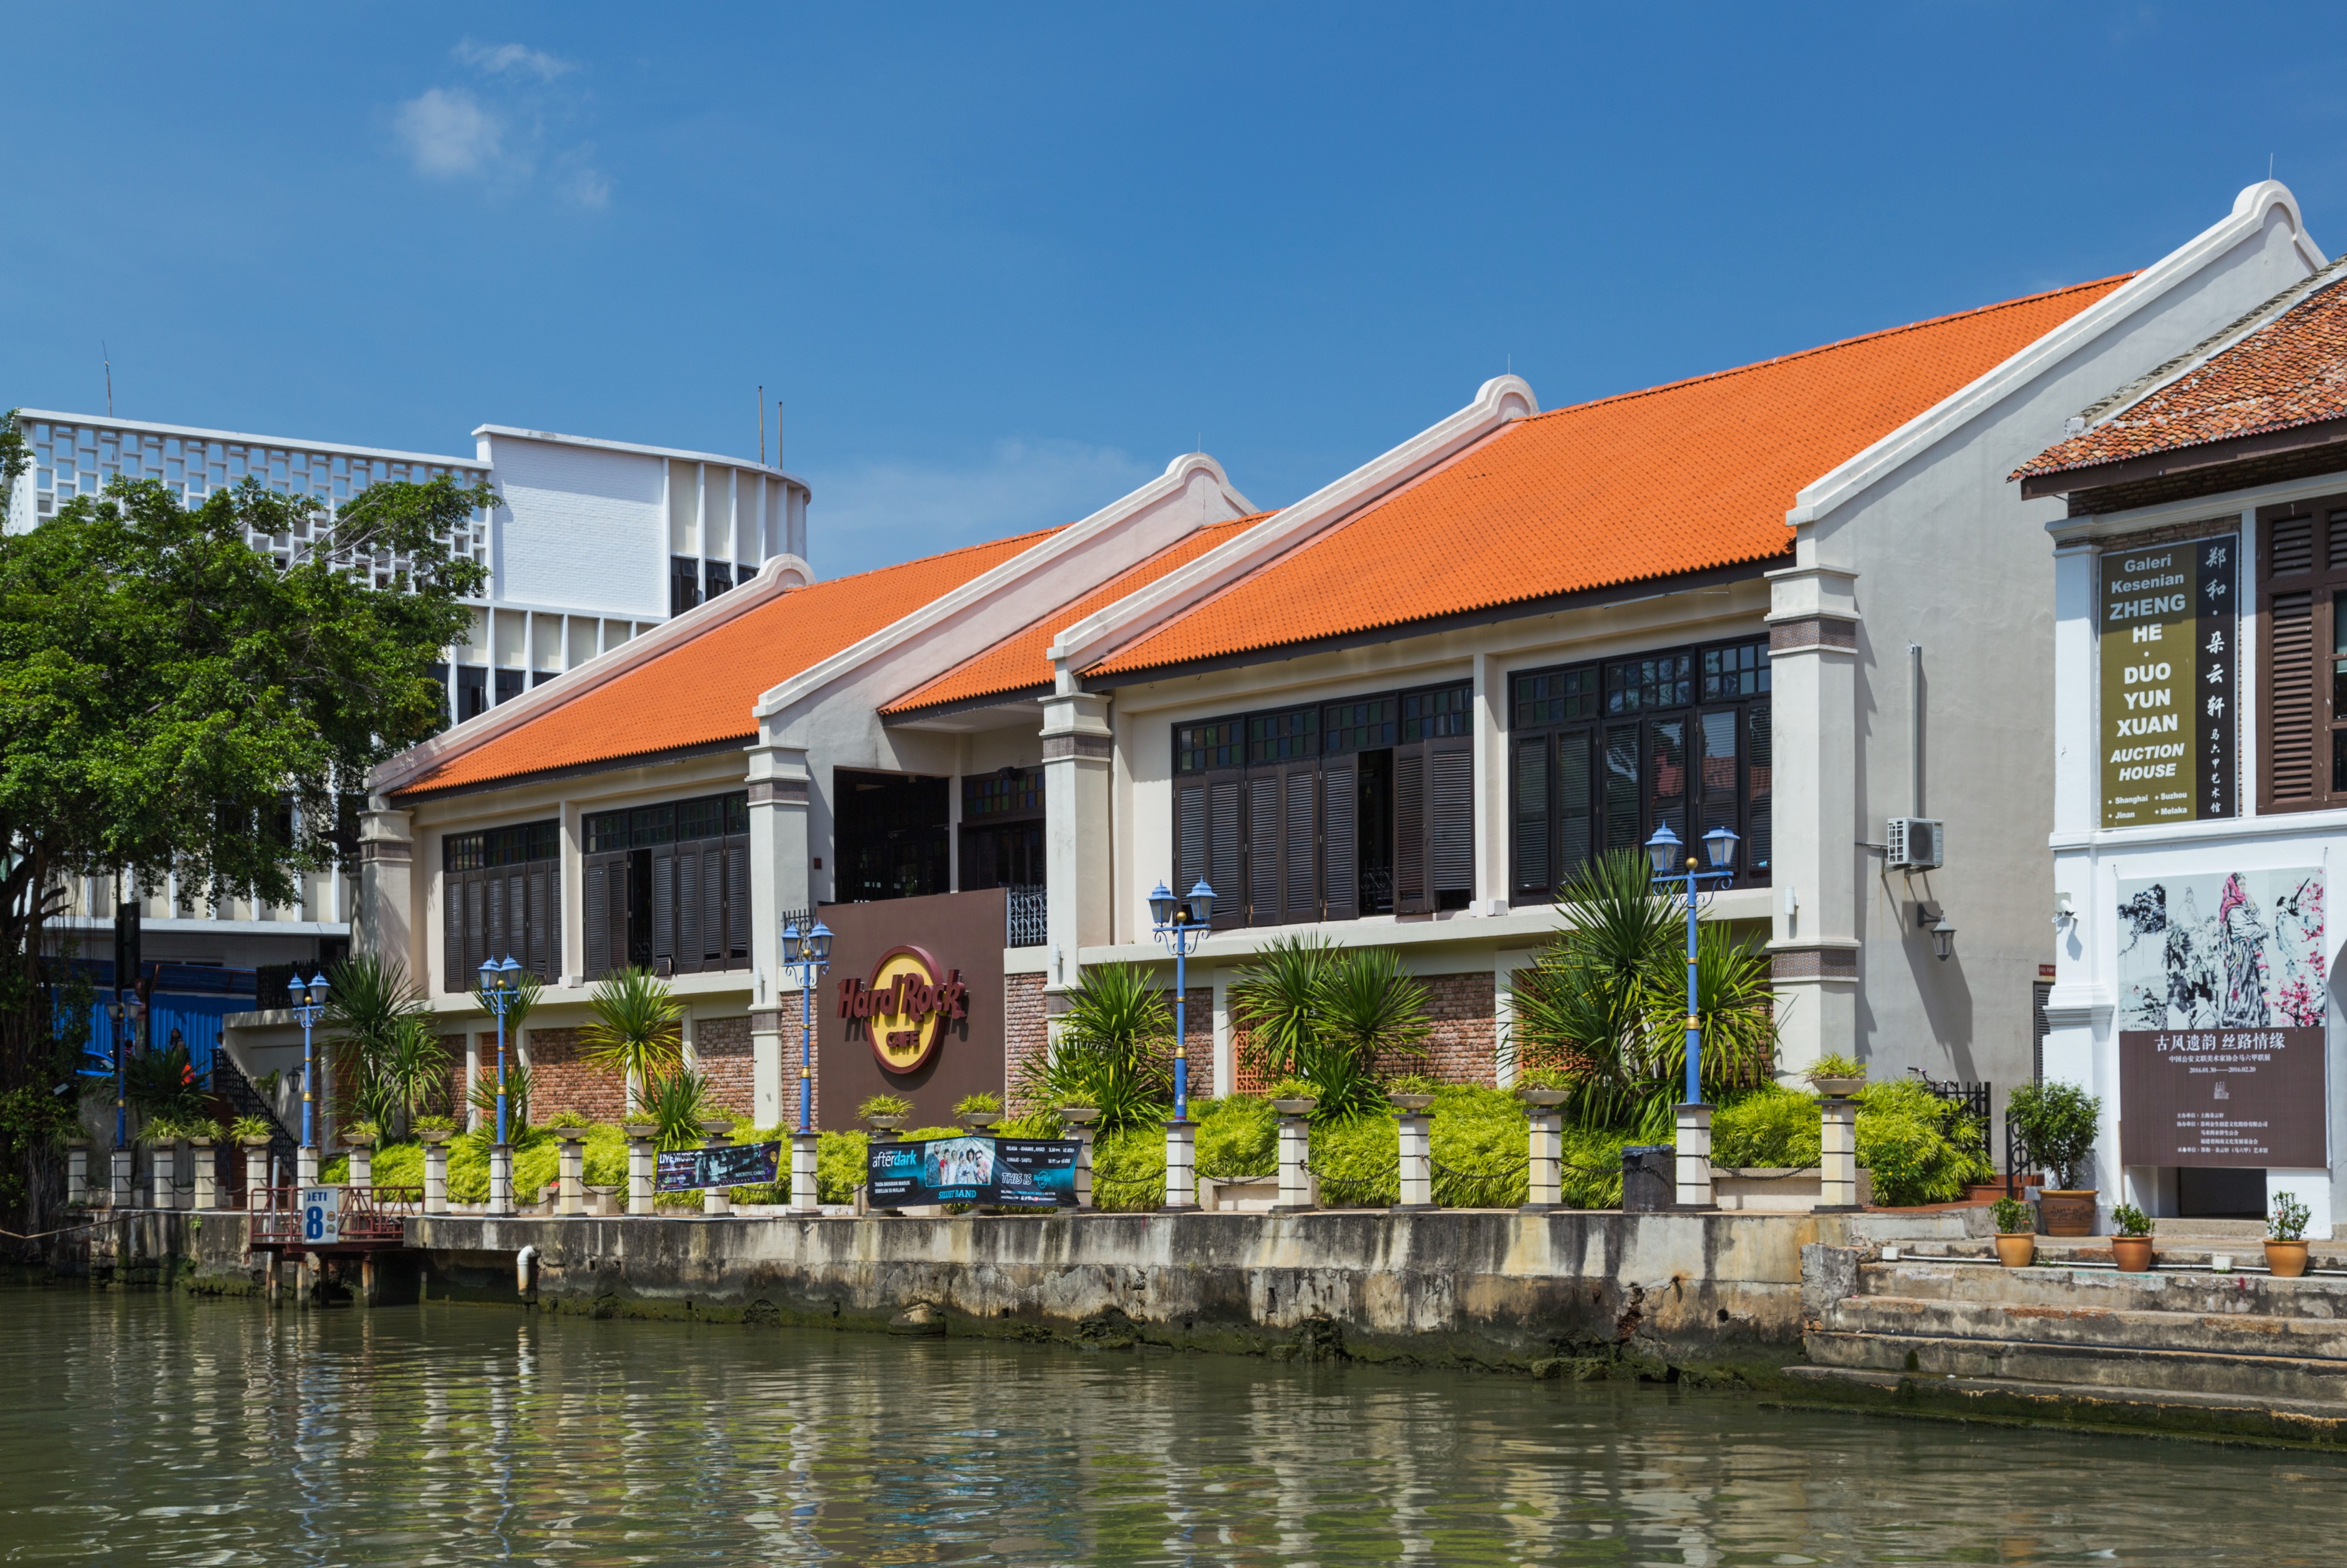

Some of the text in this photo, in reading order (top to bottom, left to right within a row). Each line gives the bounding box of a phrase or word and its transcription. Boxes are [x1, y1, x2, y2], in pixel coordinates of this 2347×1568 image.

[2125, 554, 2172, 573] Galeri
[2111, 573, 2184, 594] Kesenian
[2109, 594, 2186, 621] ZHENG
[2133, 623, 2162, 644] HE
[2124, 662, 2171, 685] DUO
[2123, 688, 2170, 710] YUN
[2116, 714, 2178, 737] XUAN
[2110, 743, 2185, 763] AUCTION
[2119, 763, 2177, 781] HOUSE
[2115, 791, 2187, 806] Shanghai Suzhou
[2115, 806, 2187, 819] Jinan Melaka
[837, 969, 966, 1023] Hard Rock
[886, 1029, 920, 1048] CAFE
[2154, 1032, 2286, 1052] 古风遗韵 丝路情缘
[659, 1152, 695, 1164] LIVE MUSIC
[872, 1150, 917, 1167] afterdark
[1002, 1173, 1032, 1185] THIS IS
[306, 1191, 327, 1201] JETI
[955, 1189, 977, 1198] BAND
[306, 1206, 323, 1240] 8
